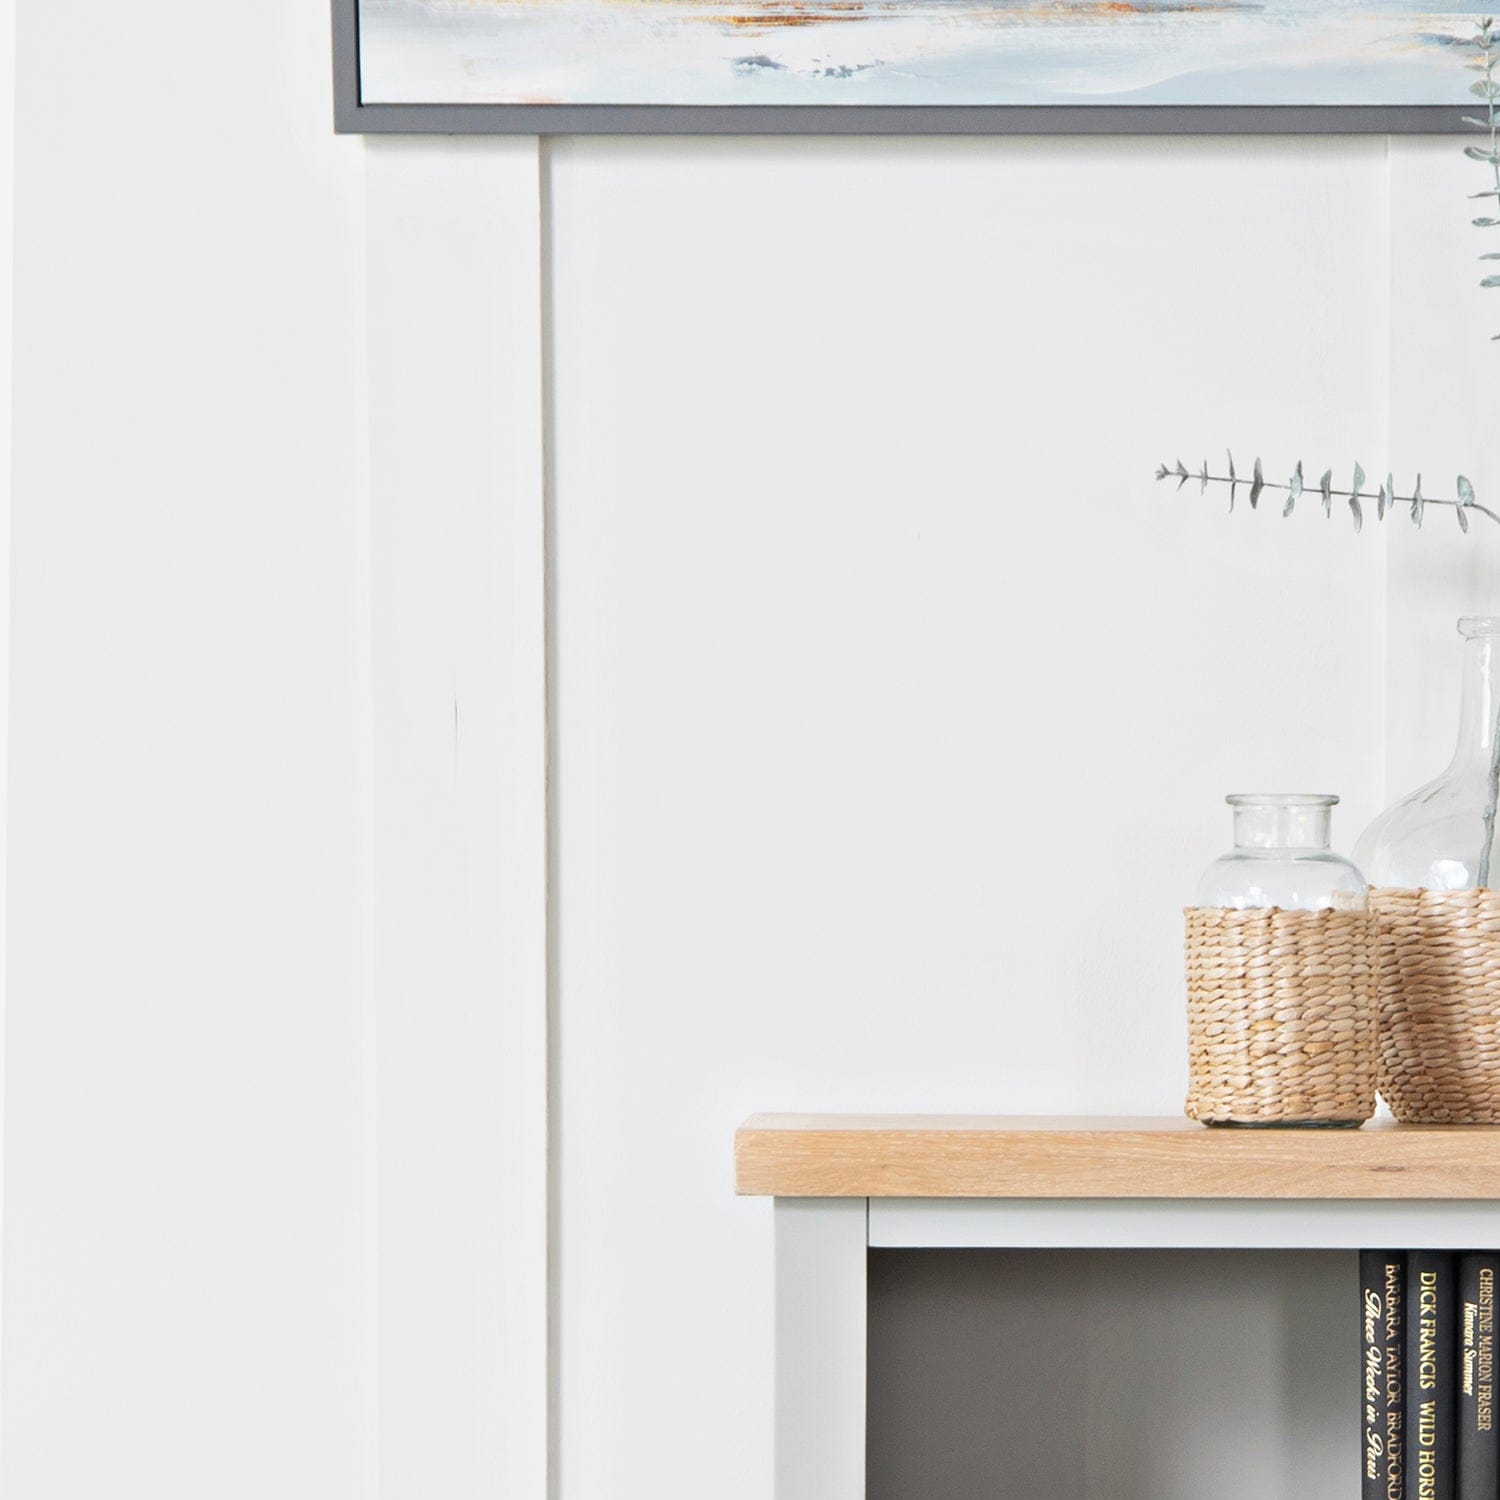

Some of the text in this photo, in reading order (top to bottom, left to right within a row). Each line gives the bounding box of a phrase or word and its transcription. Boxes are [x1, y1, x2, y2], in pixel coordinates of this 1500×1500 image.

[1384, 1264, 1401, 1341] BARBARA
[1419, 1271, 1438, 1315] DICK
[1364, 1288, 1384, 1481] Three Weeks in Paris
[1385, 1344, 1402, 1407] TAYLOR
[1418, 1318, 1438, 1390] FRANCIS
[1462, 1301, 1478, 1396] Kinvara Summer
[1476, 1267, 1494, 1431] CHRISTINE MARION FRASER
[1418, 1401, 1437, 1446] WILD
